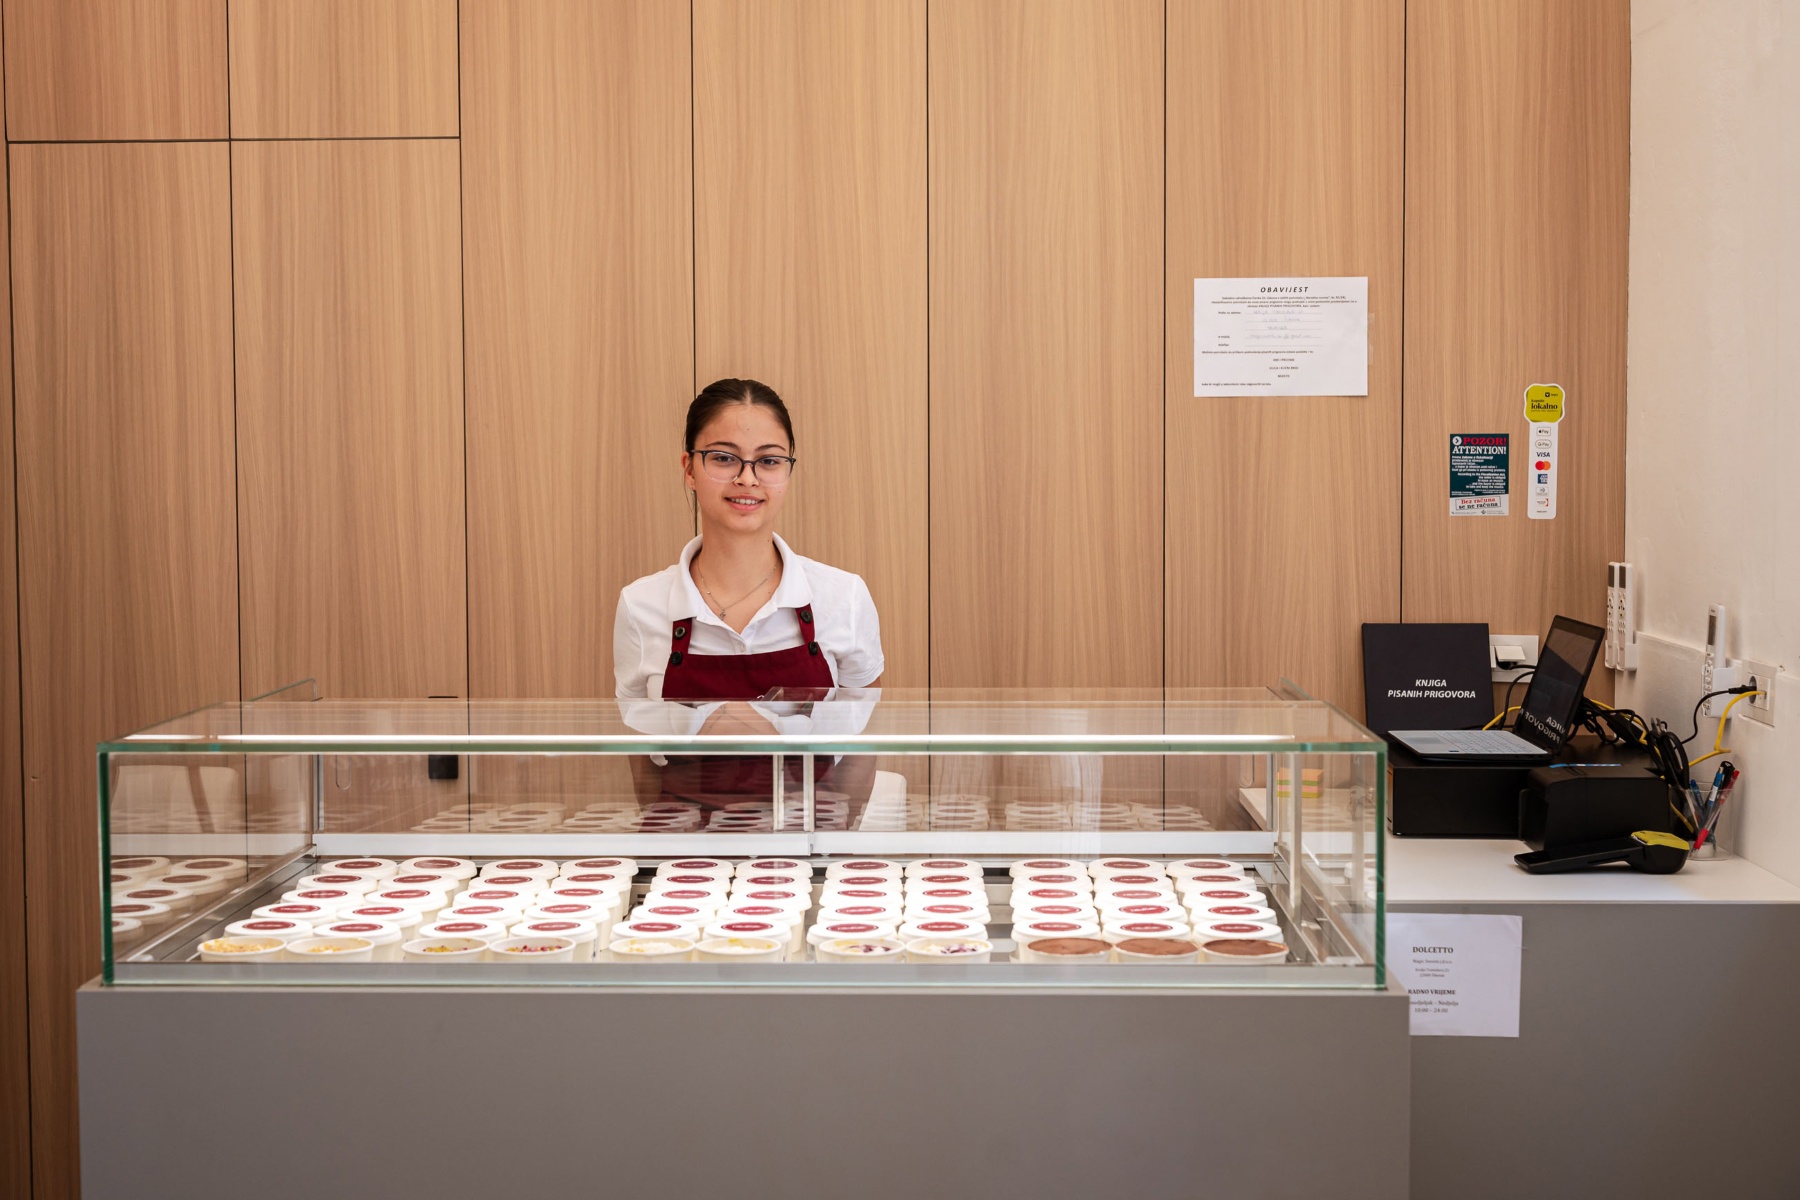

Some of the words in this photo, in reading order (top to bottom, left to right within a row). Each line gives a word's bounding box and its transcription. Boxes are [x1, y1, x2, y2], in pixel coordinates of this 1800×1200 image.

[1463, 437, 1506, 445] POZOR!
[1452, 446, 1506, 454] ATTENTION!
[1415, 679, 1447, 687] KNJIGA
[1424, 690, 1476, 699] PRIGOVORA
